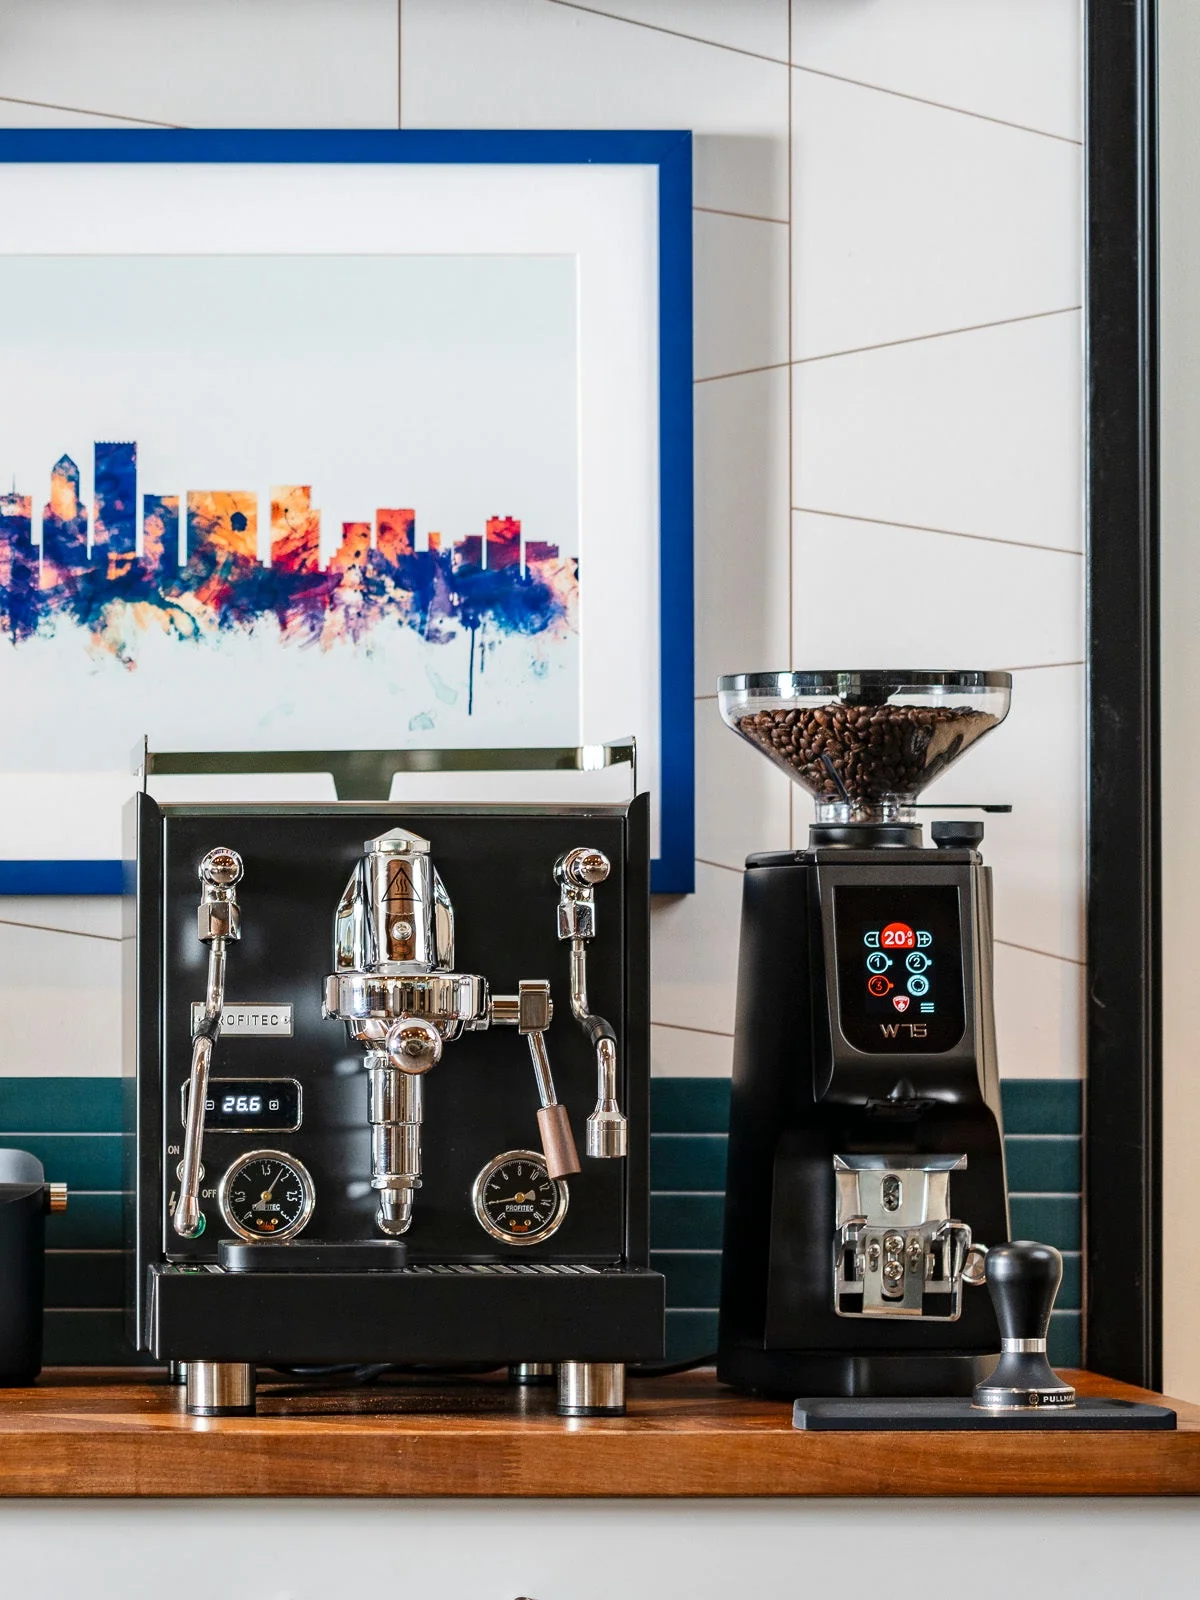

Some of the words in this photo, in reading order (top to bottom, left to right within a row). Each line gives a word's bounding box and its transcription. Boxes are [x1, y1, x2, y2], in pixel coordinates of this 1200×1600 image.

[167, 1145, 180, 1155] ON
[517, 1165, 522, 1176] 8
[529, 1169, 539, 1180] 10
[539, 1182, 550, 1192] 12
[202, 1189, 217, 1198] OFF
[505, 1204, 534, 1213] PROFITEC
